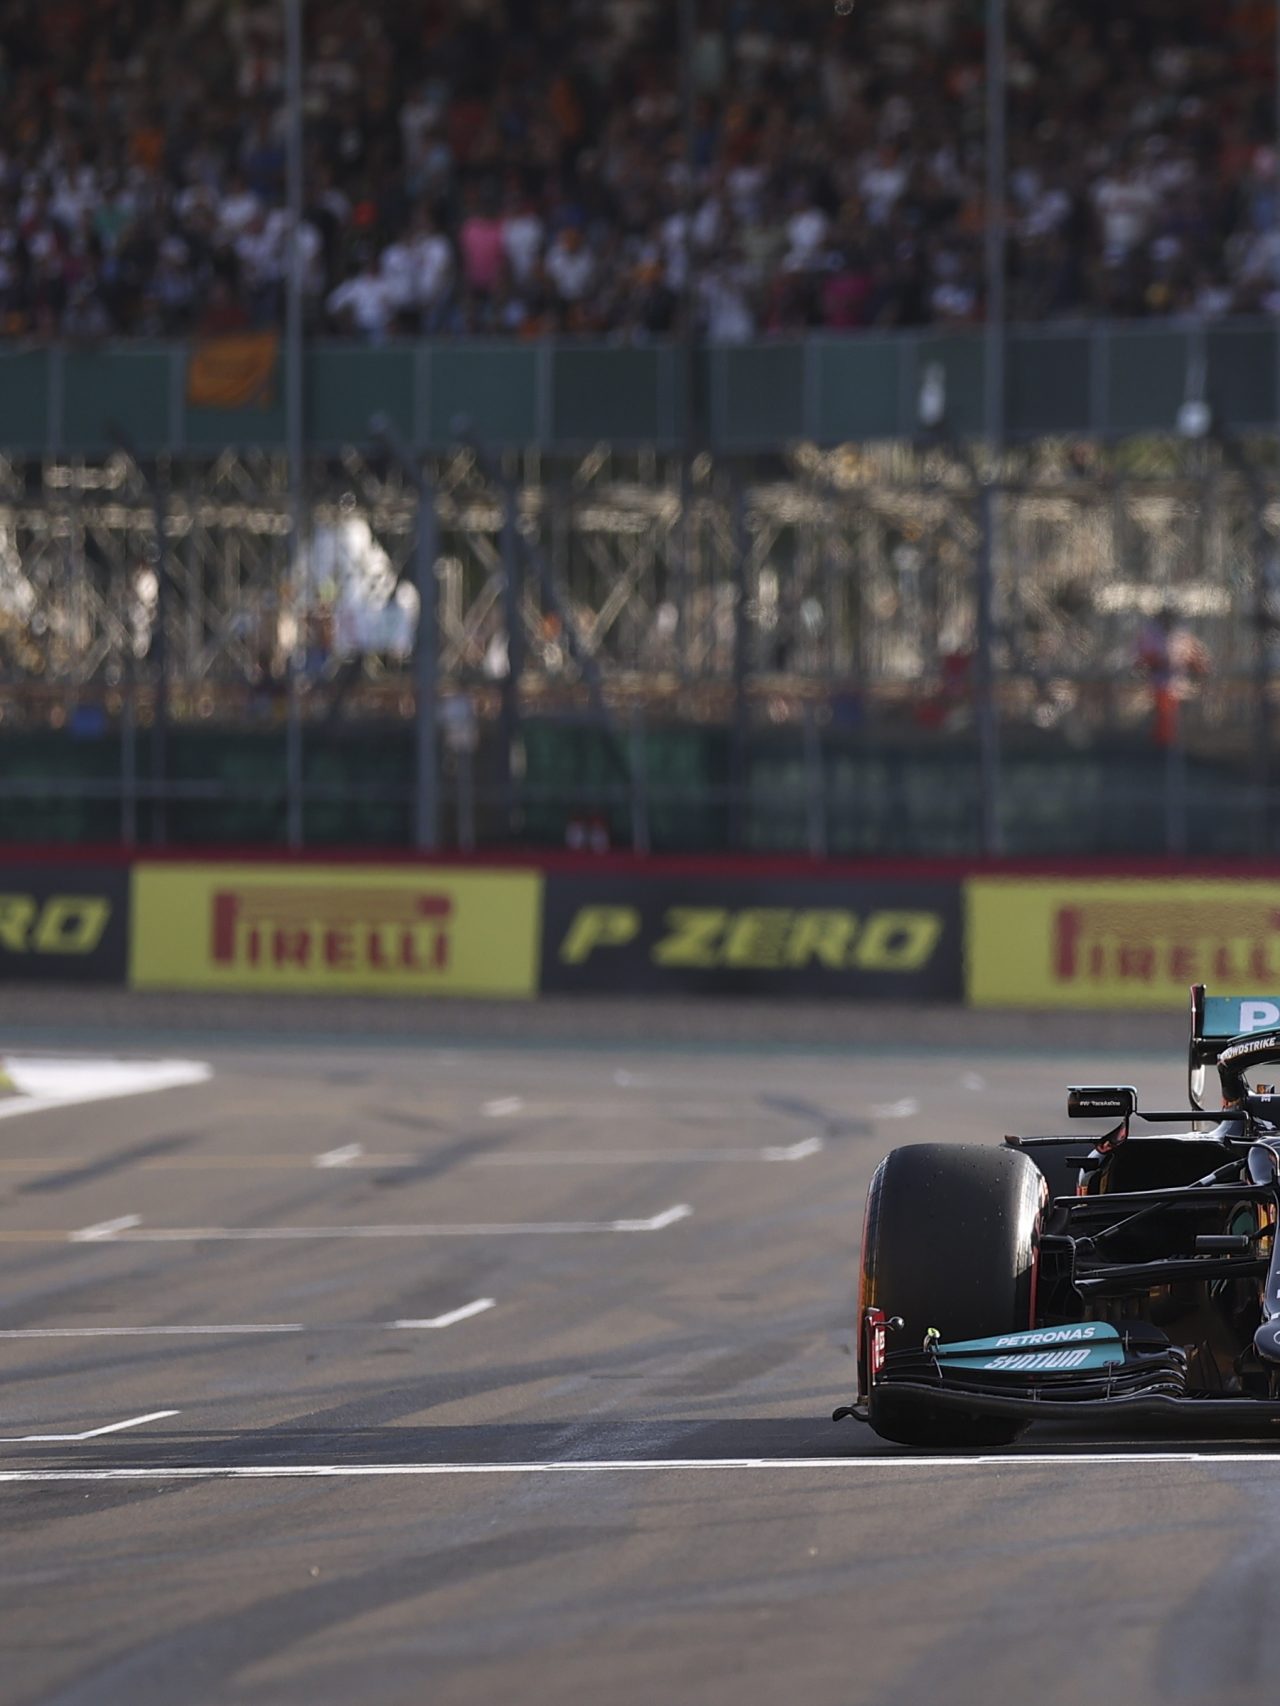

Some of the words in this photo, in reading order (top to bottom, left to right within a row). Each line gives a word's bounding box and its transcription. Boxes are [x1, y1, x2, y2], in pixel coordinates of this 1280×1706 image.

[210, 888, 455, 972] PIRELLI
[560, 905, 641, 964] P
[652, 906, 943, 970] ZERO
[995, 1327, 1095, 1346] PETRONAS
[986, 1349, 1091, 1369] SYNTIUM
